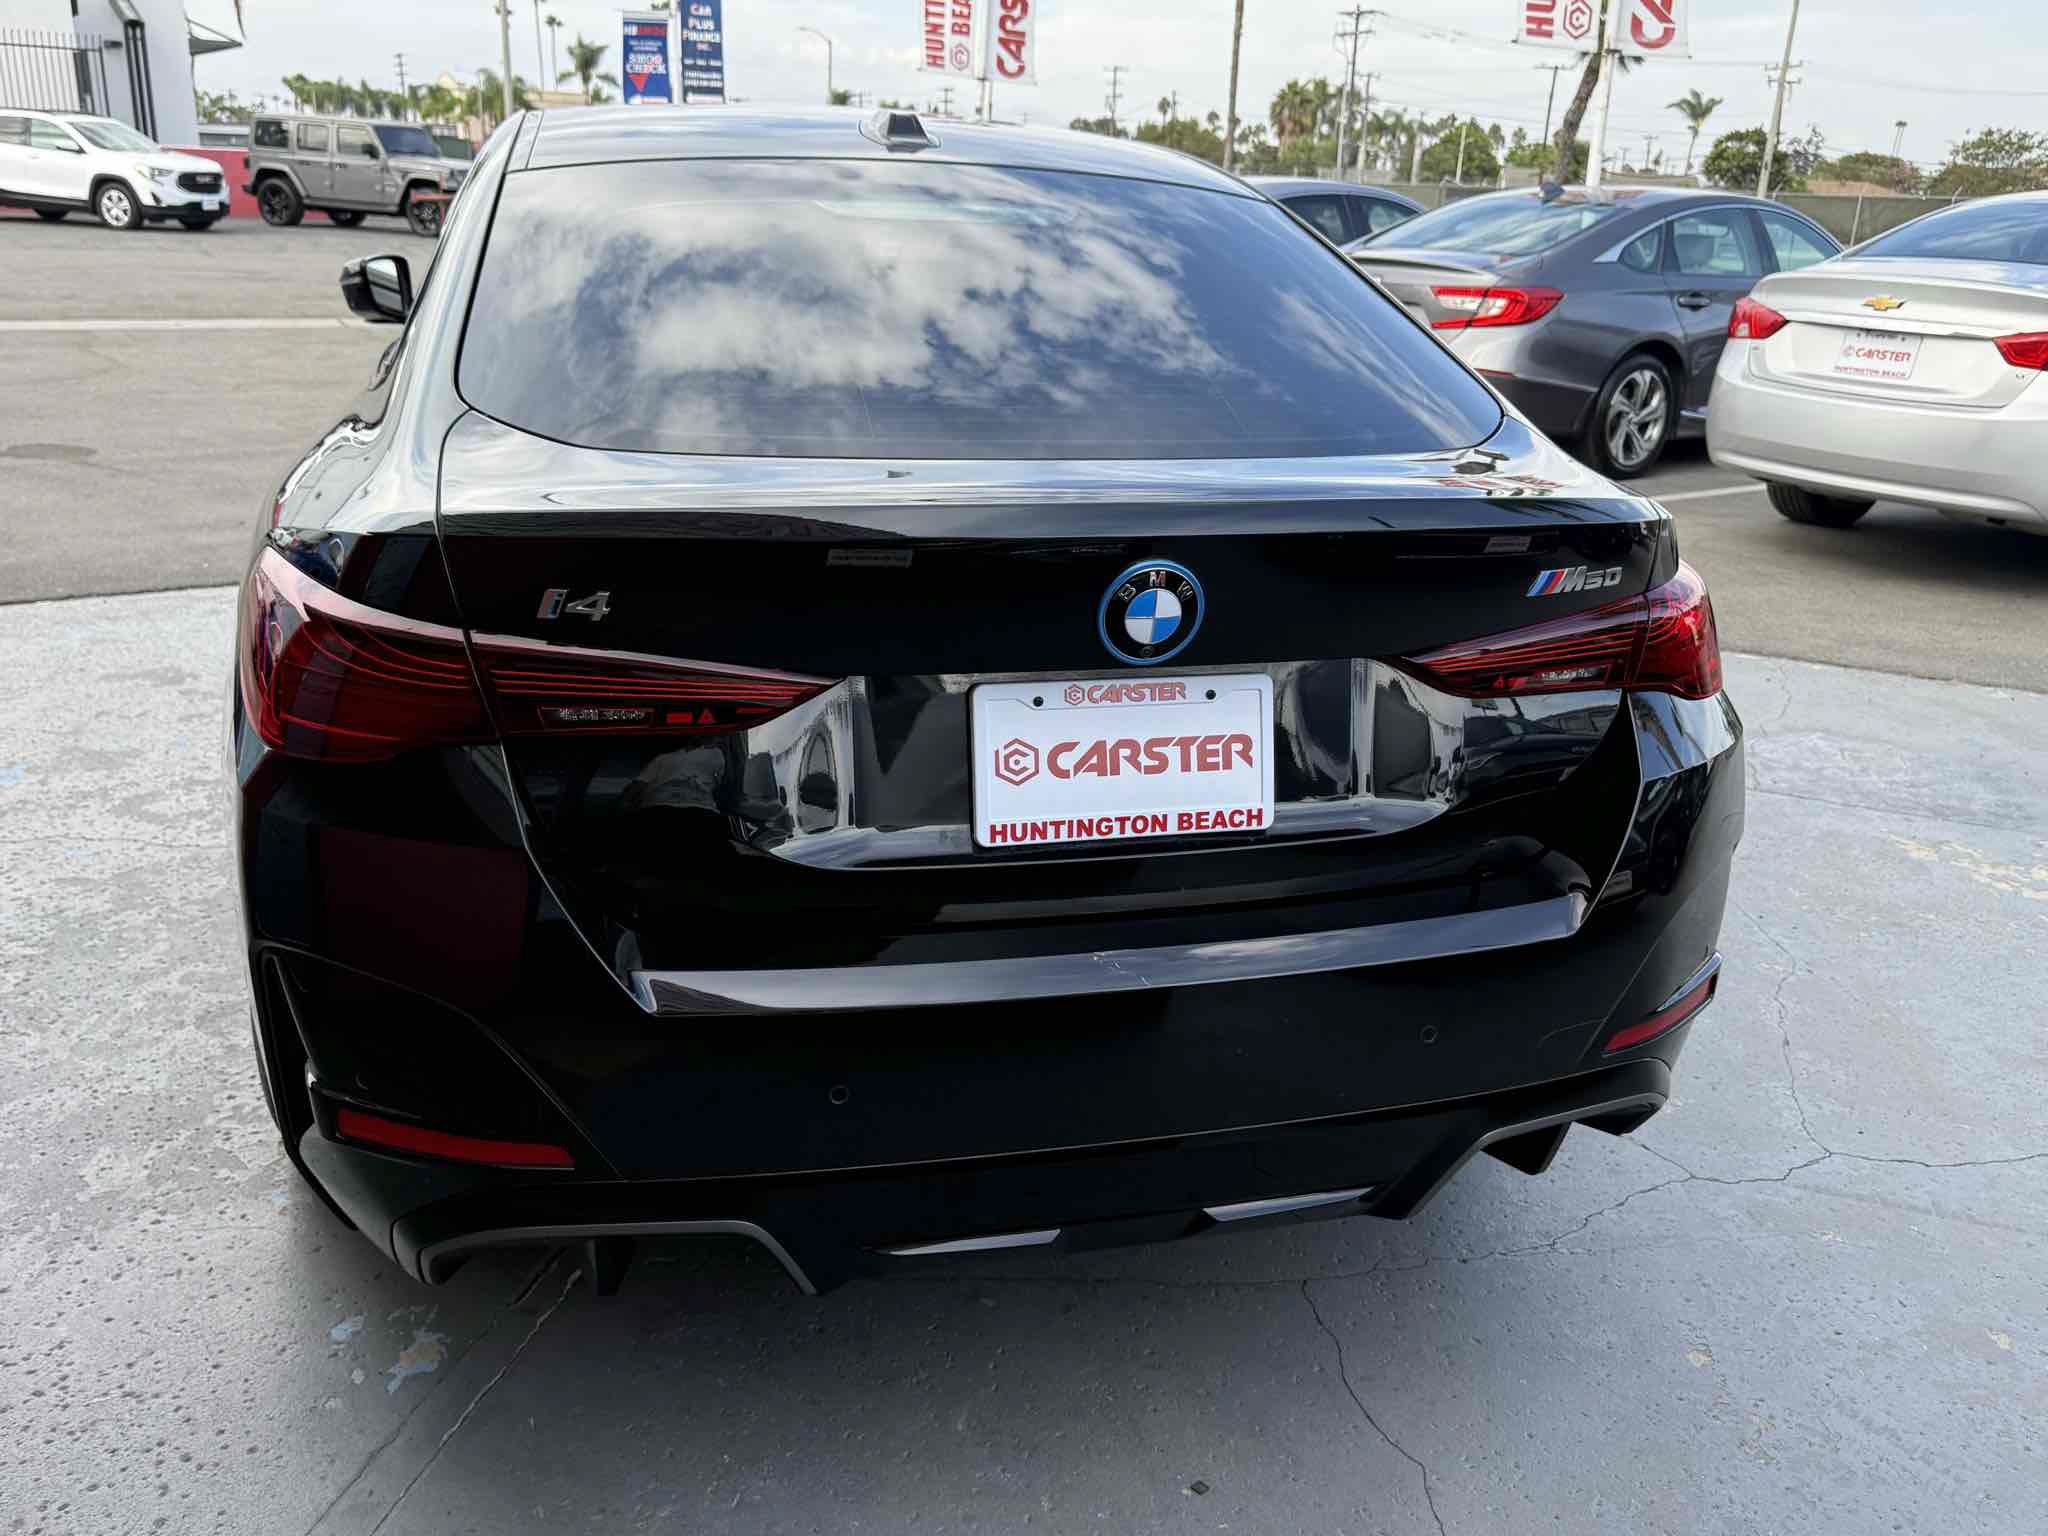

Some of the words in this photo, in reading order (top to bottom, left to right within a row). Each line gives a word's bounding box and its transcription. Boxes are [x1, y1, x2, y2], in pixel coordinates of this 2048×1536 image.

[1855, 347, 1912, 361] CARSTER
[1086, 682, 1187, 704] CARSTER
[1046, 733, 1255, 780] CARSTER
[989, 813, 1169, 844] HUNTINGTON
[1176, 807, 1264, 832] BEACH
